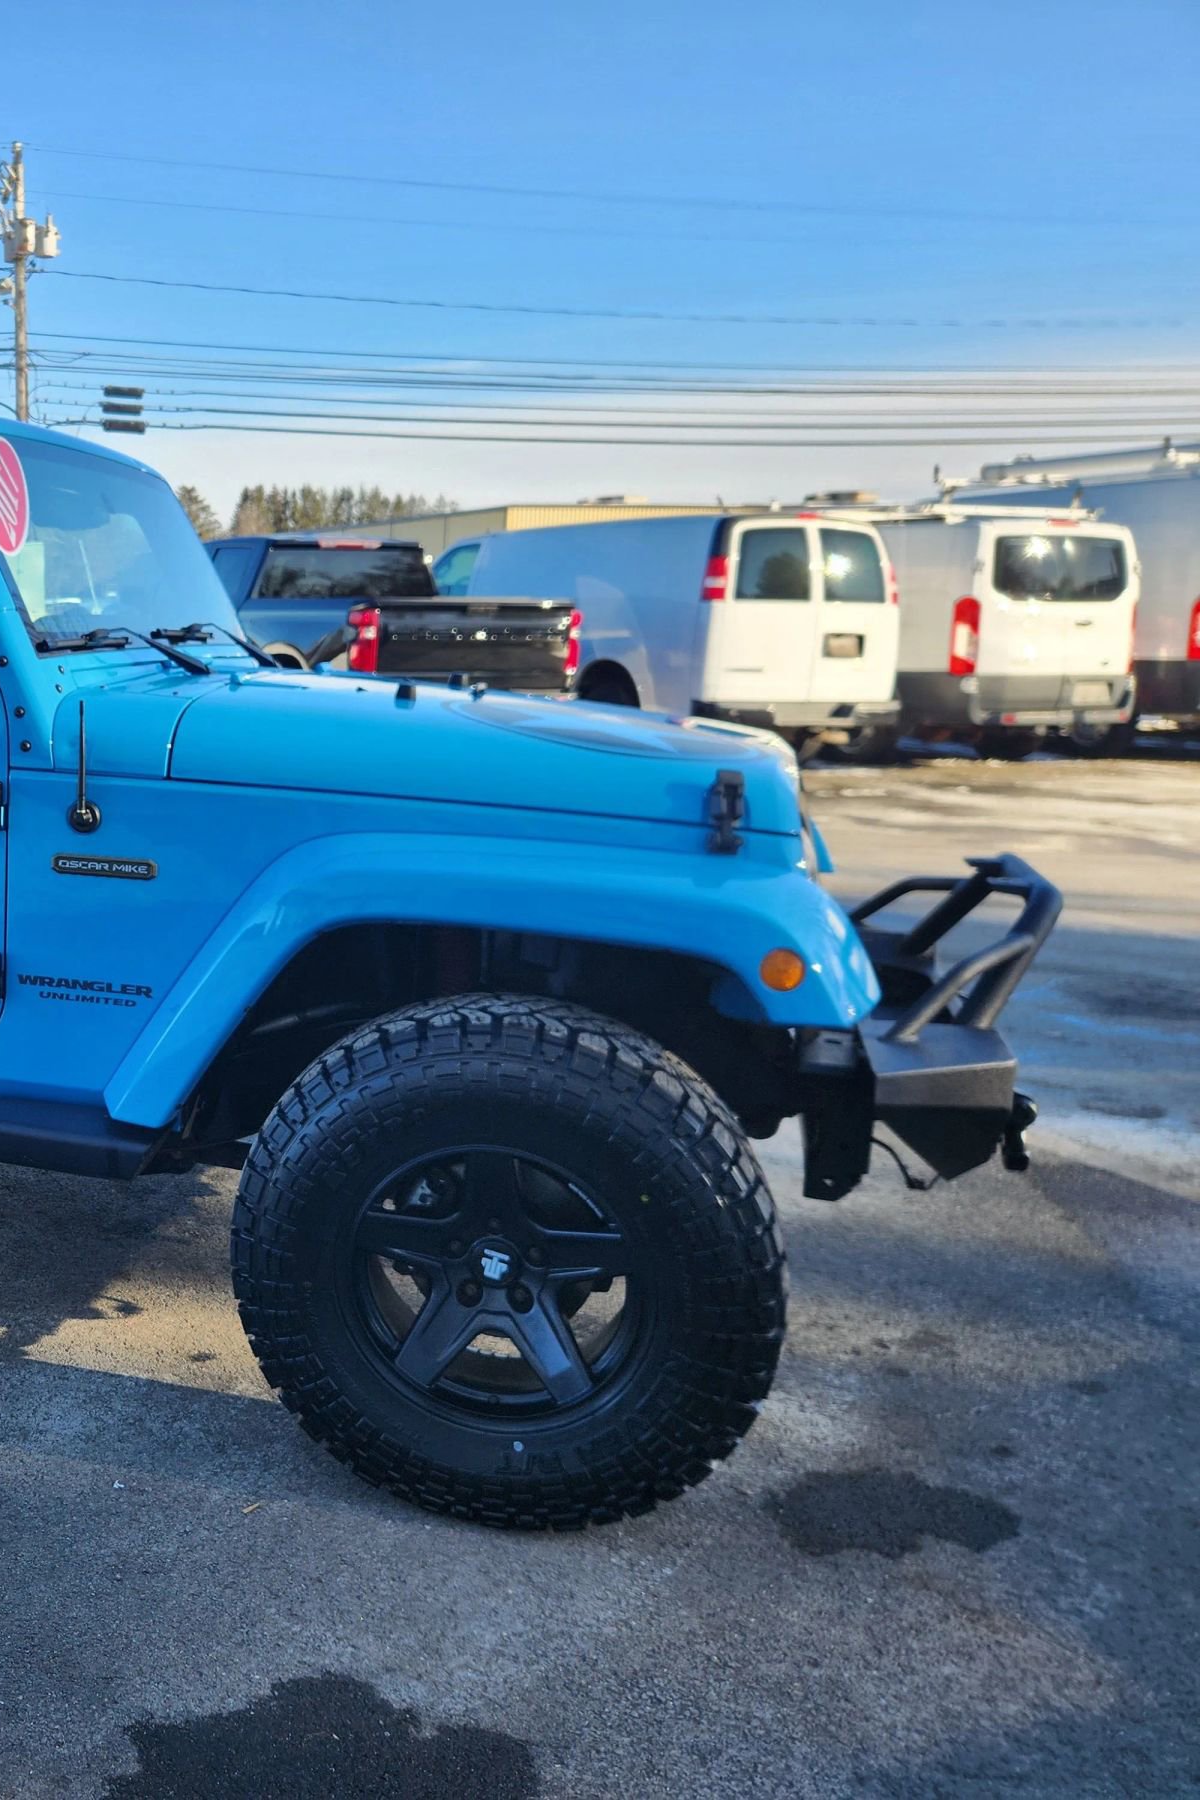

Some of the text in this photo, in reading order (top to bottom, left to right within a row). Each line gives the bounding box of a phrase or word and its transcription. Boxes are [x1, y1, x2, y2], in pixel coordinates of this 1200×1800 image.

[58, 859, 149, 874] OSCAR MIKE
[17, 973, 153, 999] WRANGLER
[39, 991, 137, 1008] UNLIMITED
